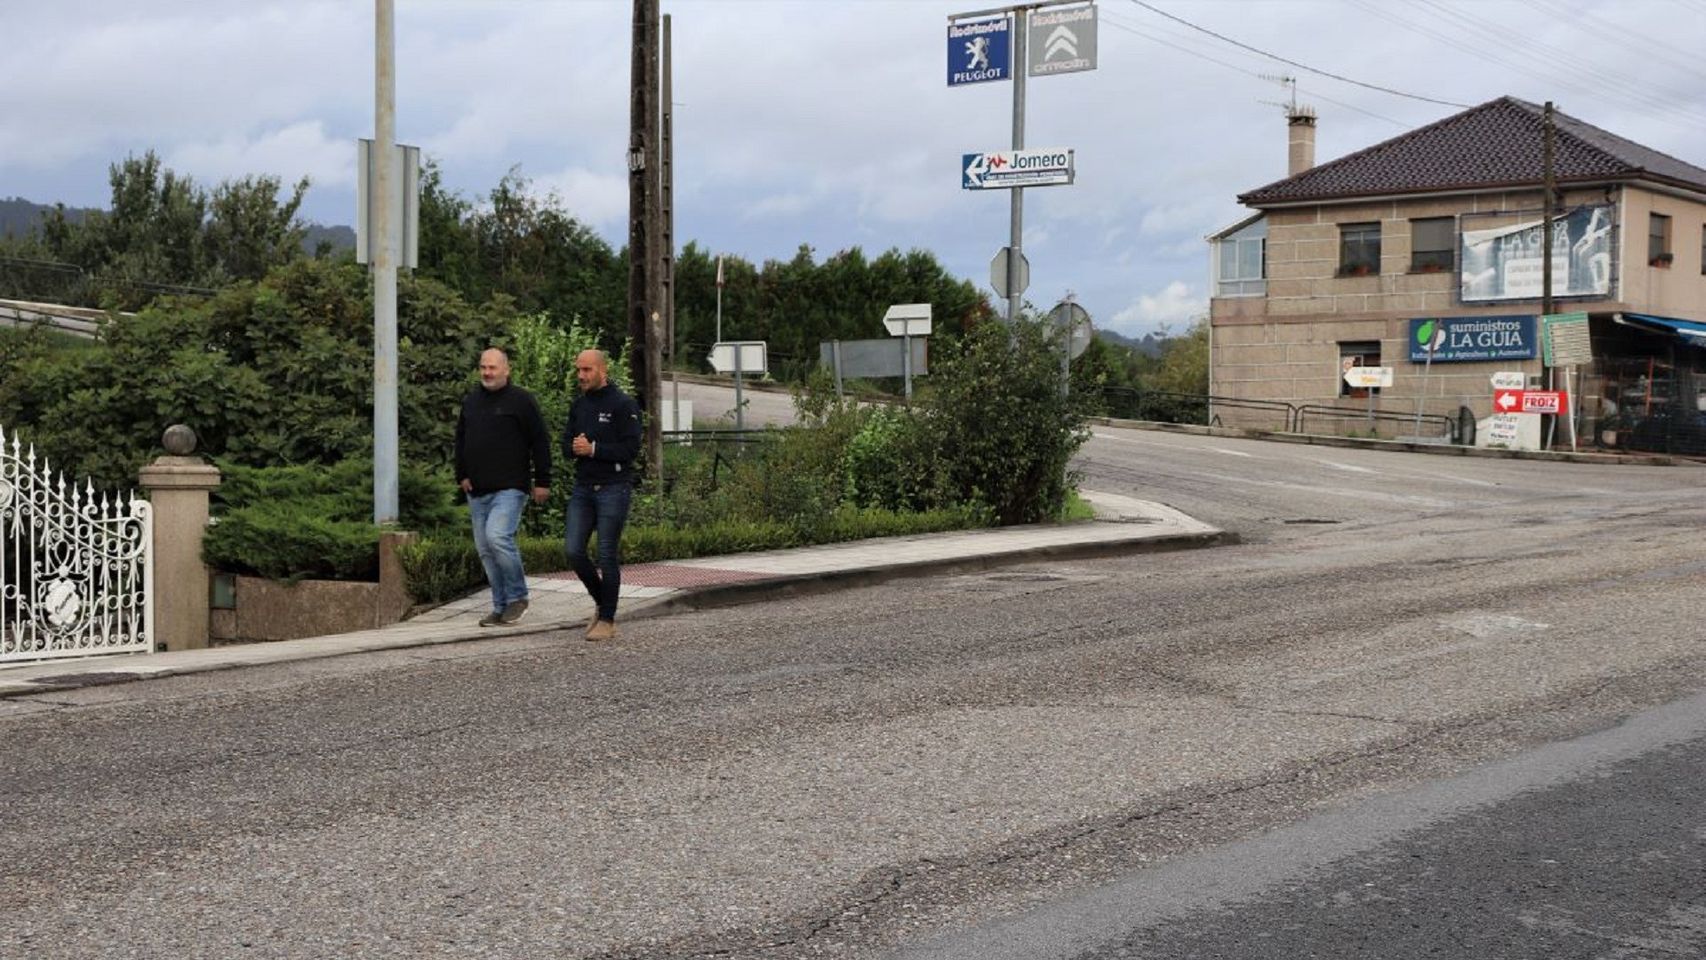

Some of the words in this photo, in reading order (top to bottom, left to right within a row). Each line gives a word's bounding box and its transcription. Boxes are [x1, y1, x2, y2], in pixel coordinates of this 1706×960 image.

[953, 67, 1002, 83] PEUGEOT
[1010, 153, 1067, 169] Jomero
[1528, 230, 1570, 249] GIA
[1449, 320, 1521, 333] suministros
[1451, 333, 1474, 348] LA
[1524, 397, 1557, 408] FROIZ
